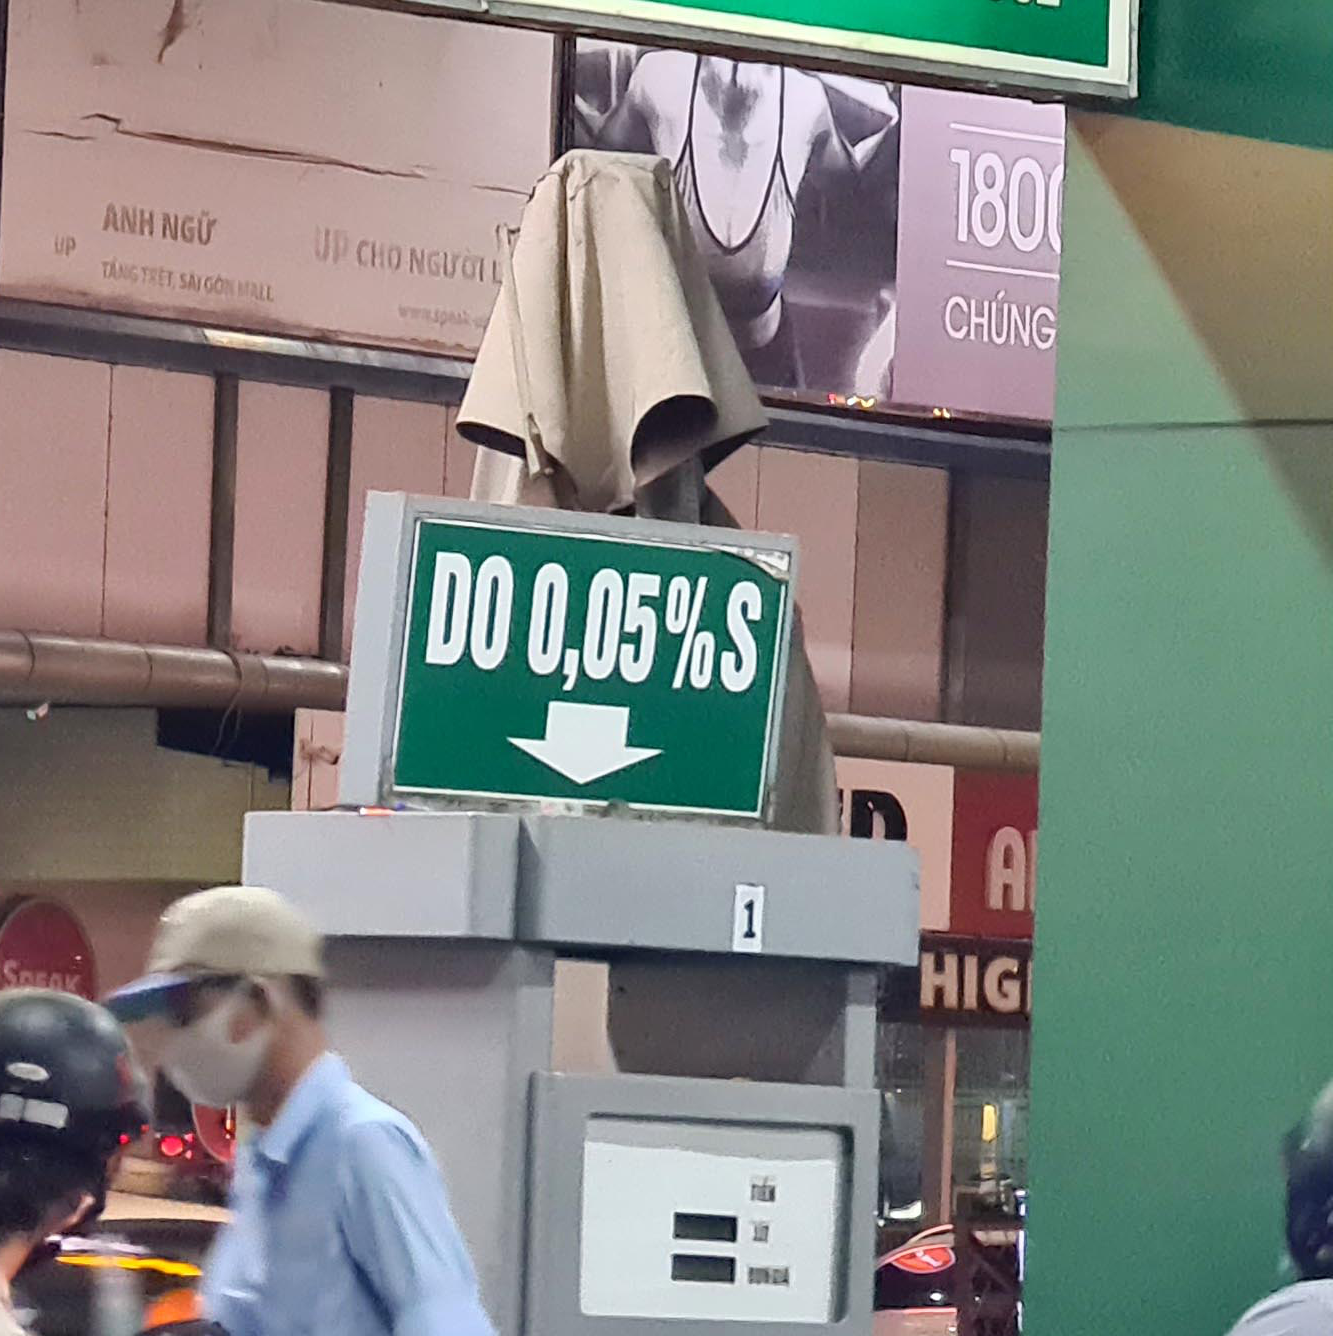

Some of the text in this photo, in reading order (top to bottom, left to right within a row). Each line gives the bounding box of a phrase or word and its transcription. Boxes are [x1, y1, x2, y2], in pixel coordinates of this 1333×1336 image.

[54, 234, 76, 257] UP
[102, 203, 218, 246] ANH NGỮ
[356, 239, 402, 271] CHO
[945, 289, 1057, 350] CHÚNG
[425, 551, 514, 670] DO
[743, 899, 756, 938] 1
[920, 951, 1032, 1013] HIG
